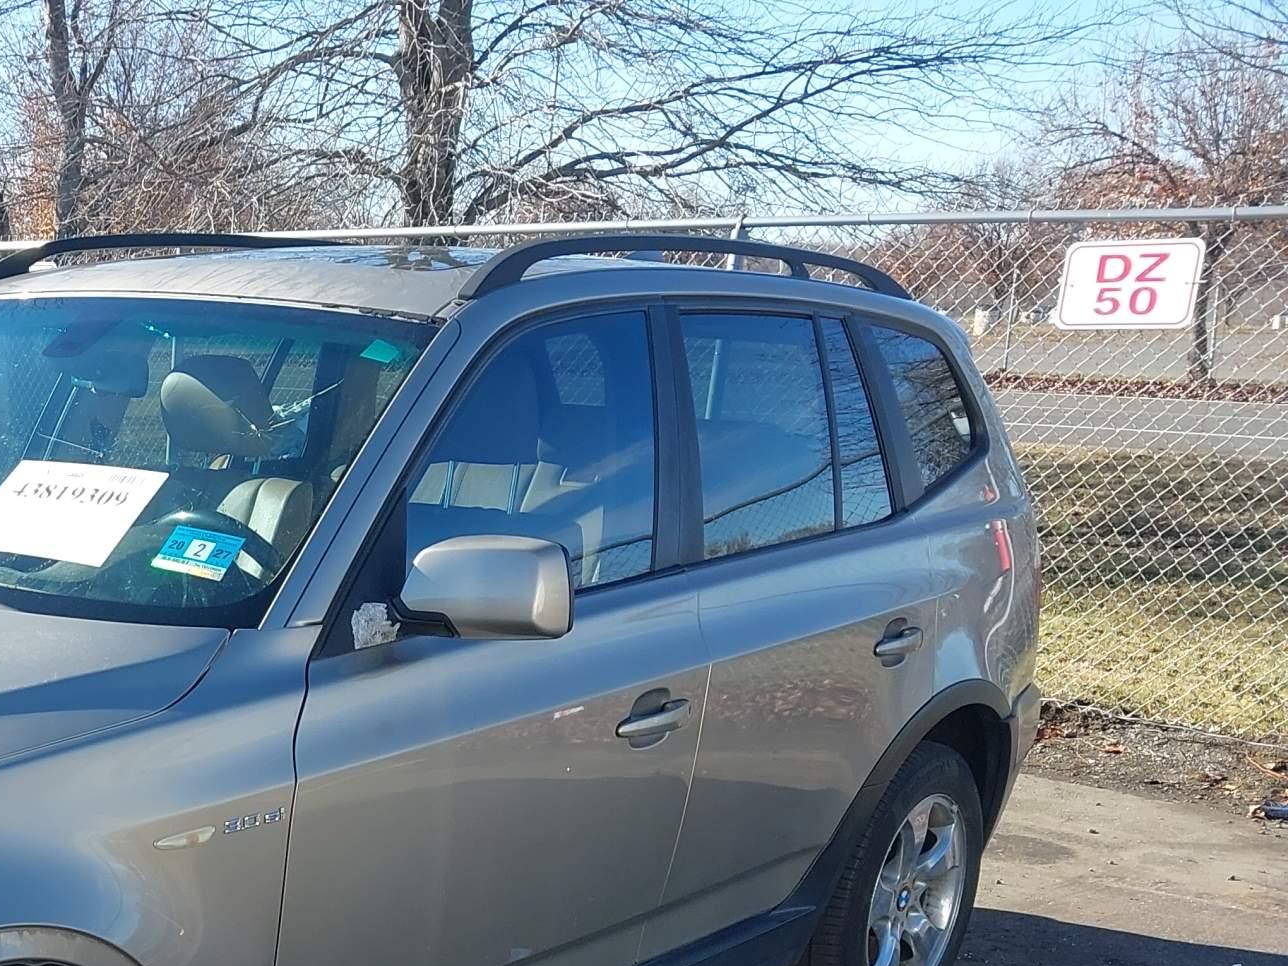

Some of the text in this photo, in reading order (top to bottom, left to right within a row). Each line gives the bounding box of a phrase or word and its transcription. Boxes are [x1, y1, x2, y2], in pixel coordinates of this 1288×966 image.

[1095, 252, 1171, 284] DZ
[1093, 286, 1158, 316] 50
[12, 482, 130, 506] 43819309
[168, 539, 232, 560] 20 2 27
